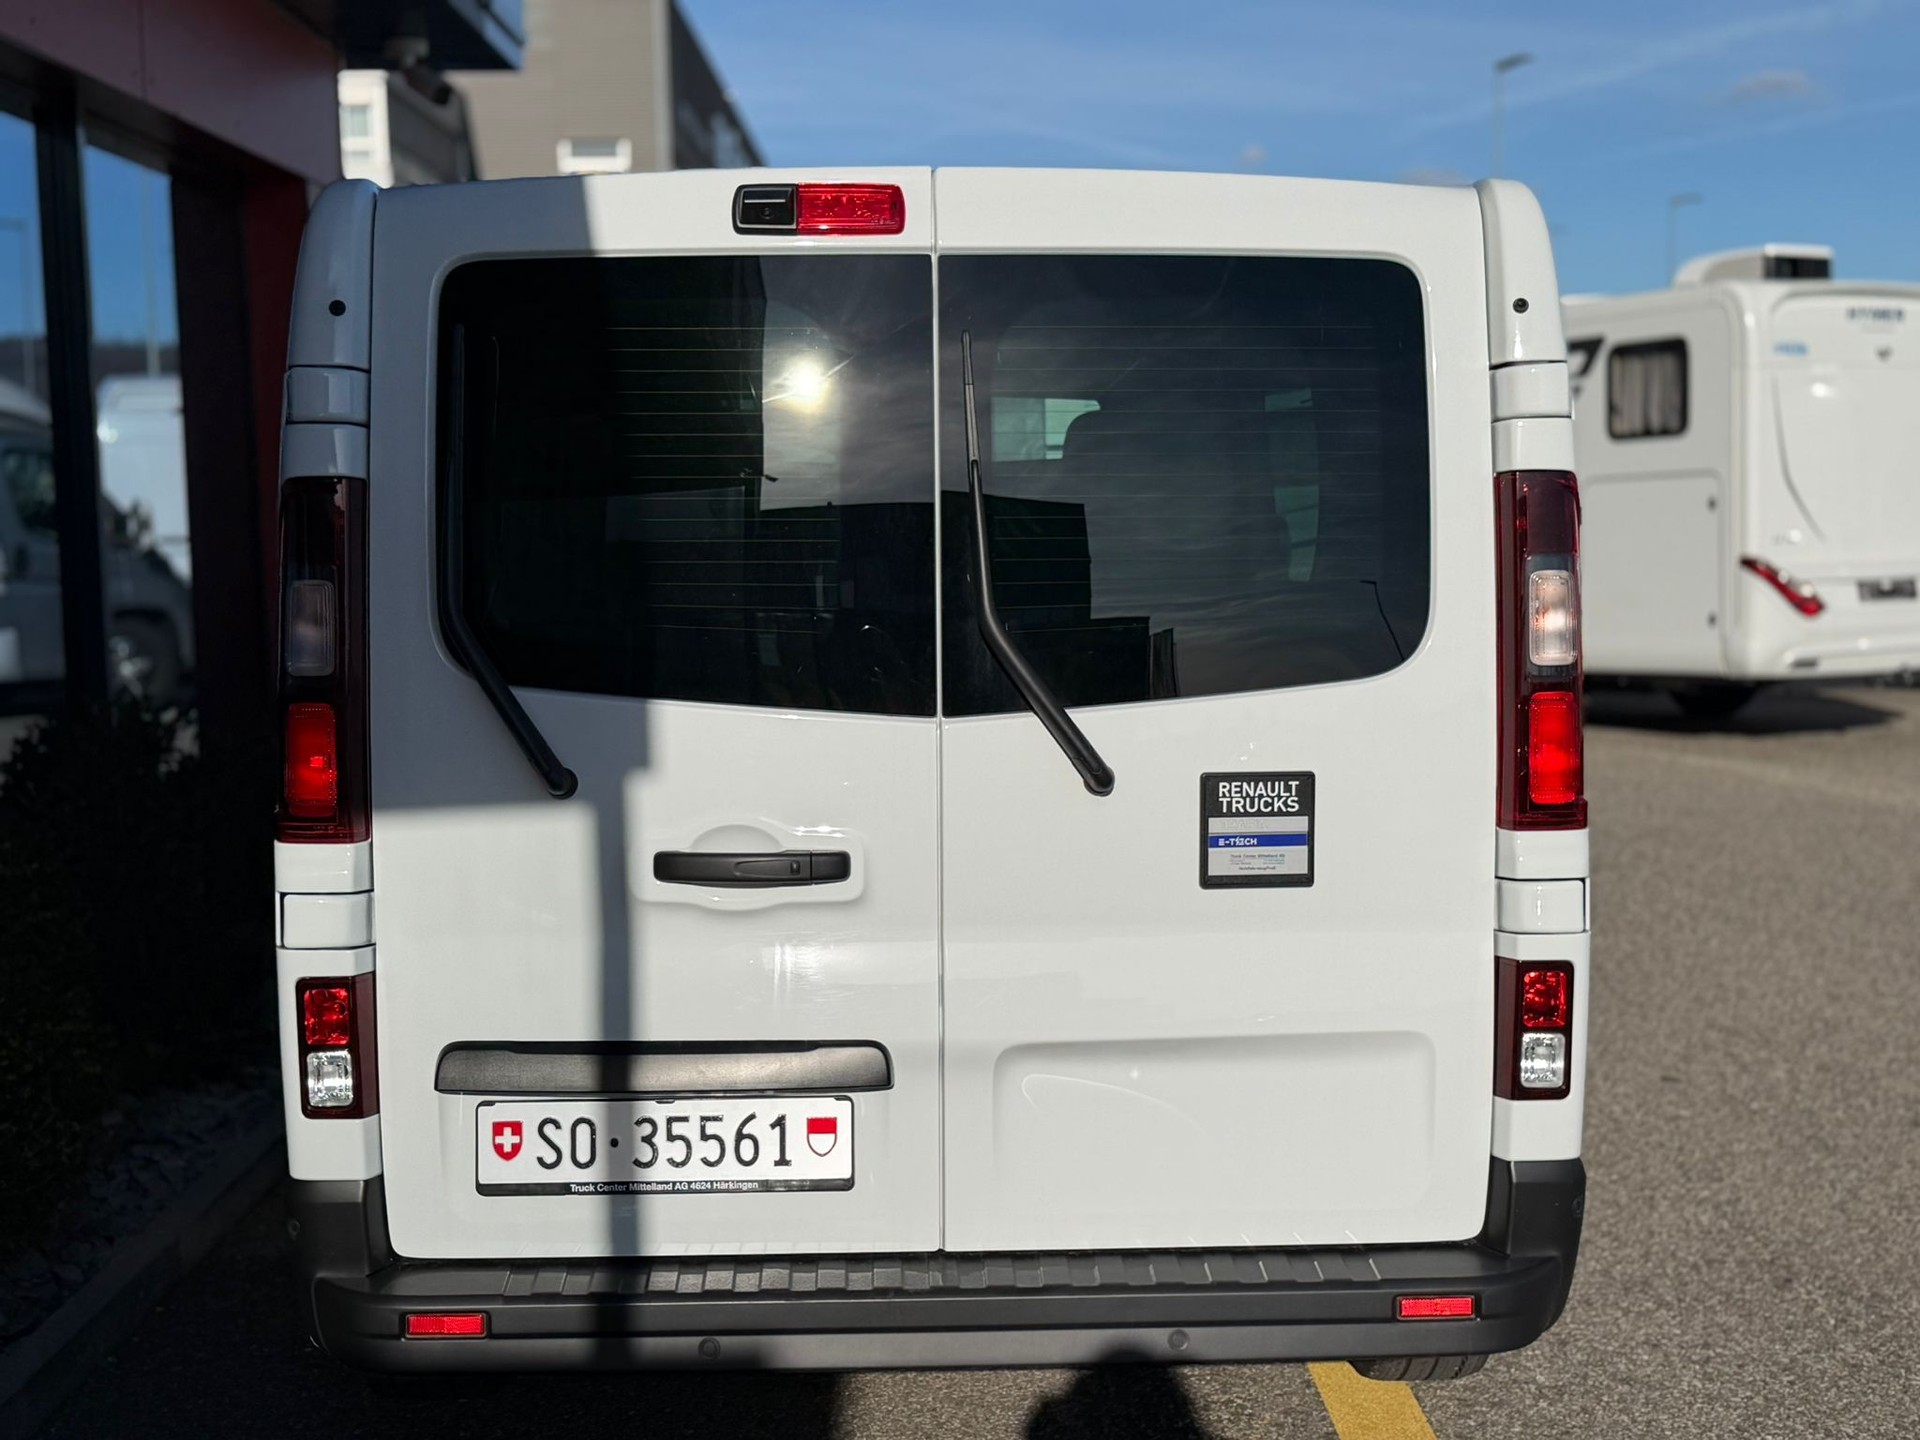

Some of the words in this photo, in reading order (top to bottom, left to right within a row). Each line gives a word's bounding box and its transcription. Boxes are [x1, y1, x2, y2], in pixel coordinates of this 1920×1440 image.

[1218, 781, 1300, 797] RENAULT
[1218, 796, 1300, 813] TRUCKS
[536, 1116, 597, 1170] SO
[632, 1112, 793, 1170] 35561
[570, 1183, 594, 1192] Truck
[597, 1183, 627, 1192] Center
[629, 1182, 673, 1191] Mittelland
[674, 1182, 689, 1190] AG
[690, 1181, 711, 1190] 4624
[713, 1181, 759, 1191] Härkingen
